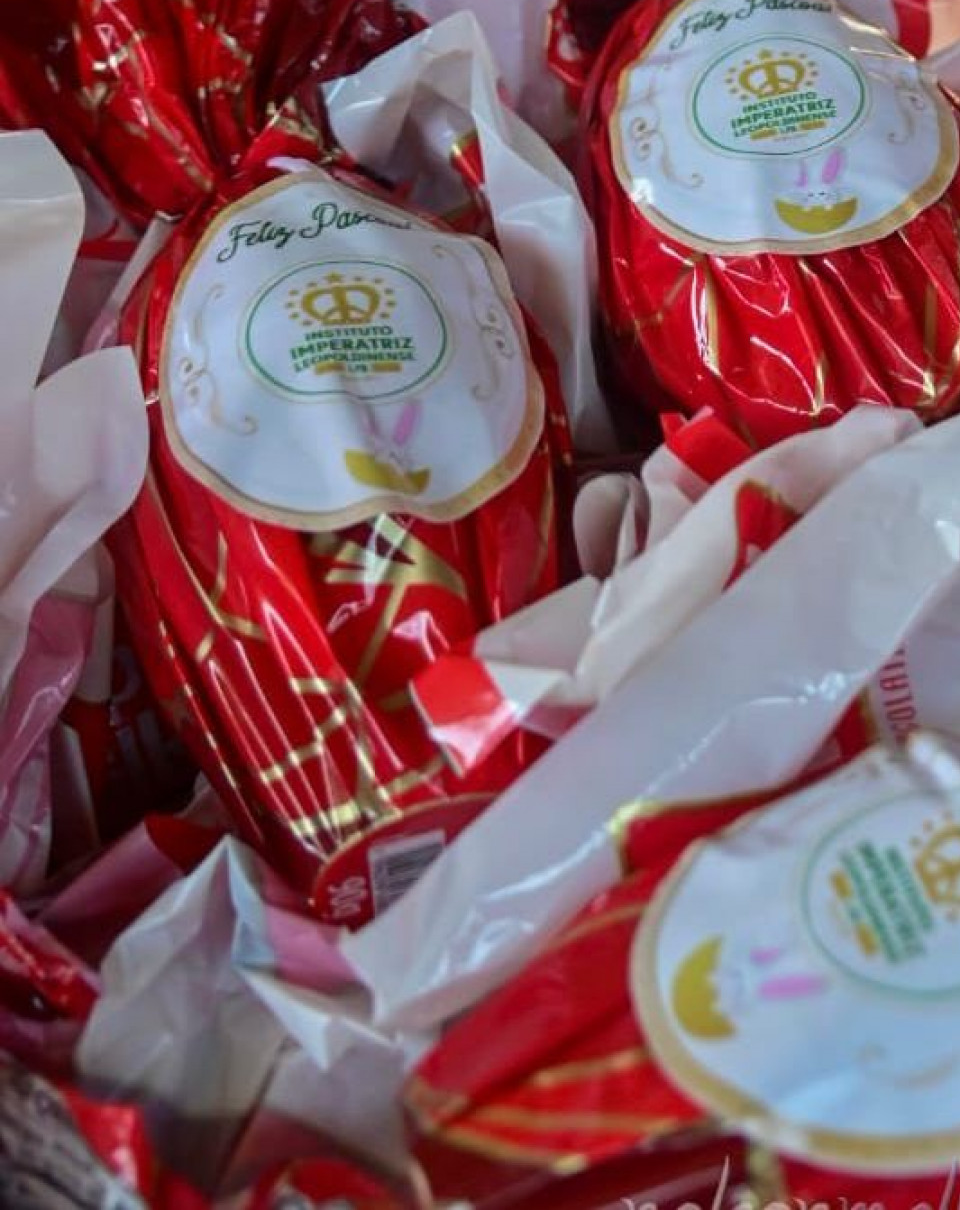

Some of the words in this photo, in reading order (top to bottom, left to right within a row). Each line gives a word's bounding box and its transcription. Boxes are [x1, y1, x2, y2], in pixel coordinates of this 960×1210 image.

[730, 98, 837, 129] IMPERATRIZ
[216, 219, 294, 263] Feliz
[290, 336, 416, 360] IMPERATRIZ
